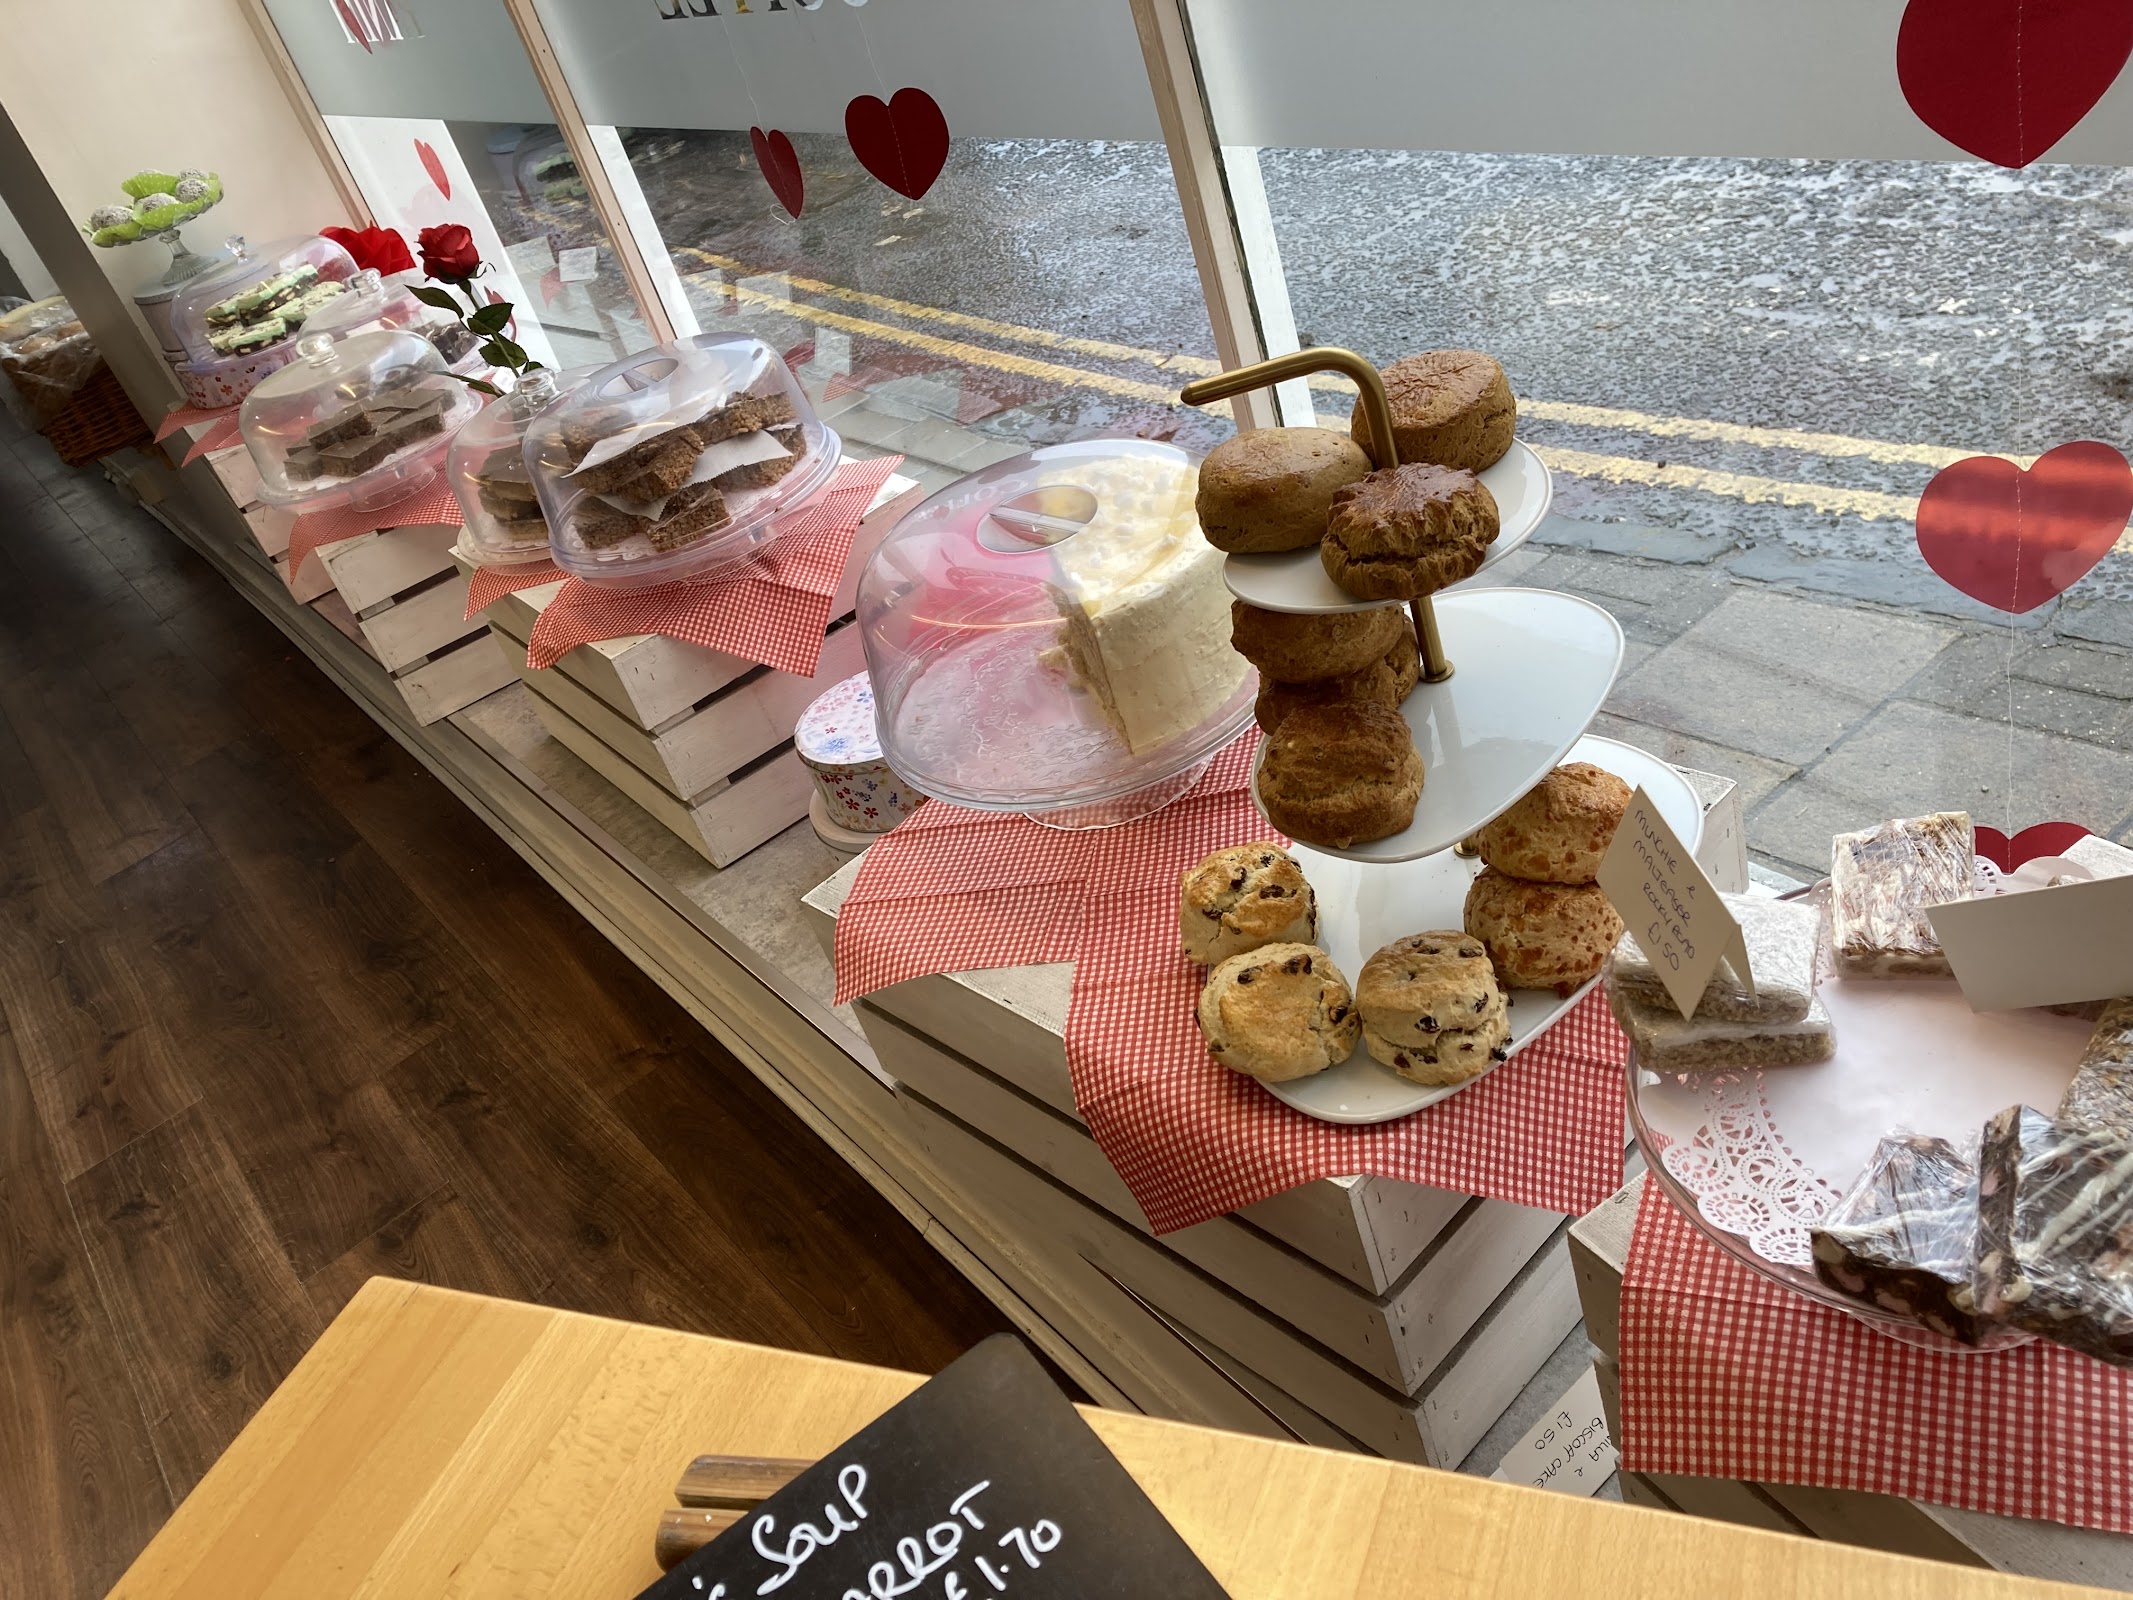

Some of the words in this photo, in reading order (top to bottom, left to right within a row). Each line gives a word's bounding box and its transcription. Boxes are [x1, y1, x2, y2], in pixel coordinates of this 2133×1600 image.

[1635, 810, 1679, 875] MUNCHIE
[1633, 840, 1692, 928] MALTEASER
[1642, 882, 1673, 926] ROCKY
